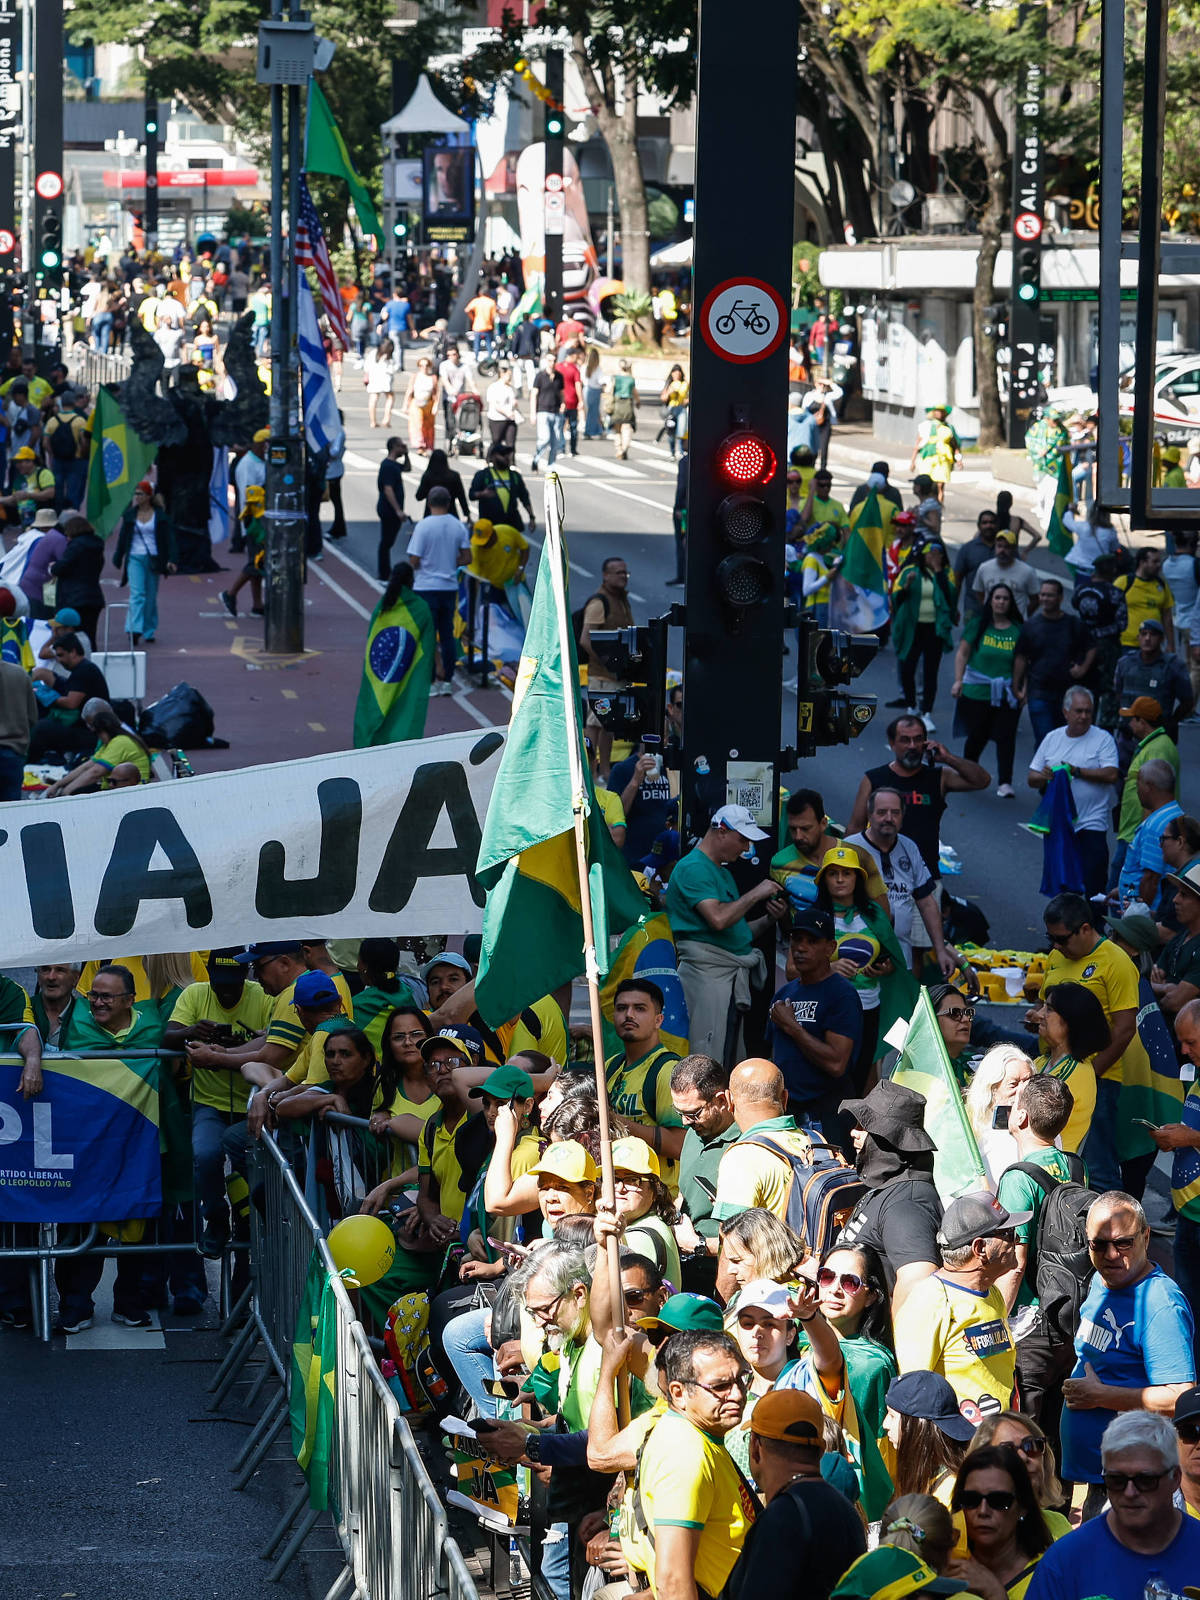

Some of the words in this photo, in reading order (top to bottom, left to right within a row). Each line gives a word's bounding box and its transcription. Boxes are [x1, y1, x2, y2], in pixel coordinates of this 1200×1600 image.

[256, 731, 504, 919] JÁ
[28, 1171, 64, 1179] LIBERAL
[8, 1178, 51, 1187] LEOPOLDO
[53, 1180, 72, 1188] /MG
